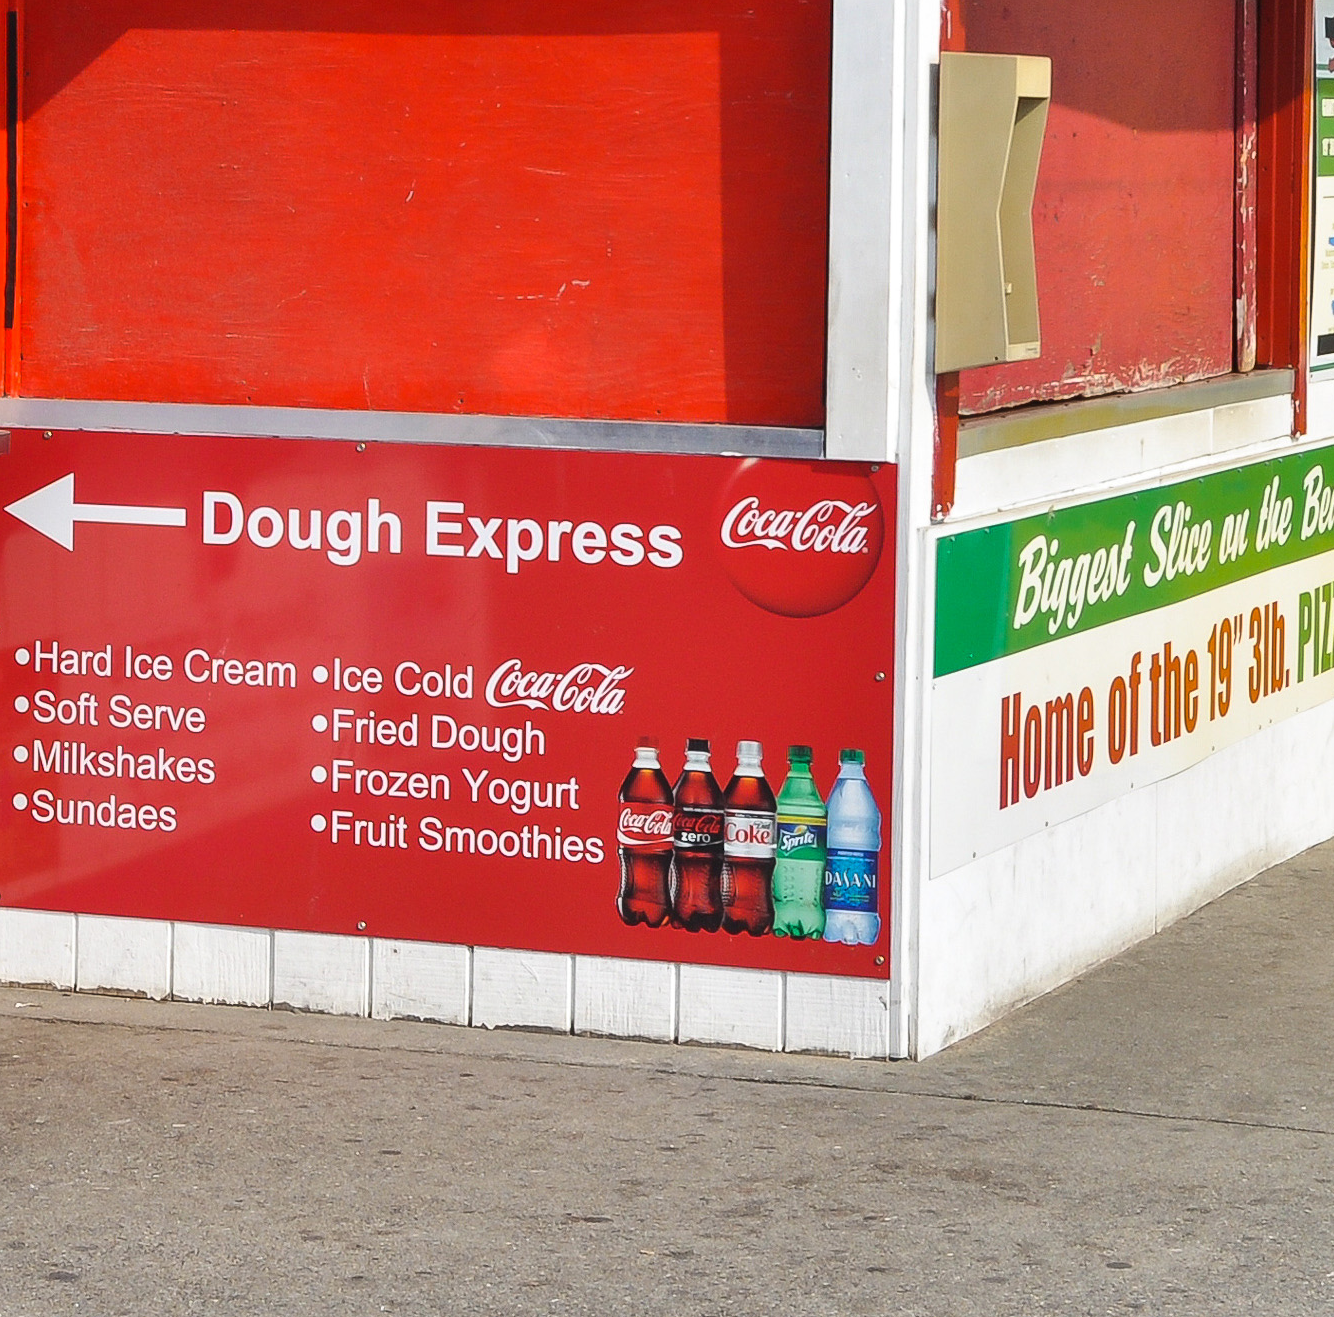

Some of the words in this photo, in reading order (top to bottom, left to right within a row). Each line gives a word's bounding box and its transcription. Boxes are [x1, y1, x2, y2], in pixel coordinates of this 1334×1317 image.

[202, 491, 404, 565] Dough
[425, 501, 684, 574] Express
[721, 496, 877, 554] Coca-Cola
[1013, 521, 1137, 635] Biggest
[1144, 500, 1212, 589] Slice
[1219, 513, 1248, 565] on
[1256, 474, 1293, 552] the
[34, 641, 113, 678] Hard
[124, 647, 173, 681] Ice
[183, 648, 296, 688] Cream
[334, 657, 383, 693] Ice
[393, 662, 474, 699] Cold
[485, 659, 634, 715] Coca-Cola
[33, 691, 99, 728] Soft
[108, 694, 206, 733] Serve
[332, 709, 420, 748] Fried
[430, 715, 546, 763] Dough
[1000, 686, 1093, 810] Home
[1108, 651, 1142, 766] of
[1150, 641, 1198, 749] the
[32, 740, 216, 783] Milkshakes
[331, 760, 451, 798] Frozen
[461, 769, 580, 812] Yogurt
[32, 789, 177, 832] Sundaes
[331, 810, 408, 849] Fruit
[418, 816, 605, 865] Smoothies
[681, 832, 711, 843] zero
[781, 831, 815, 852] Sprite
[825, 871, 877, 889] DASANI
